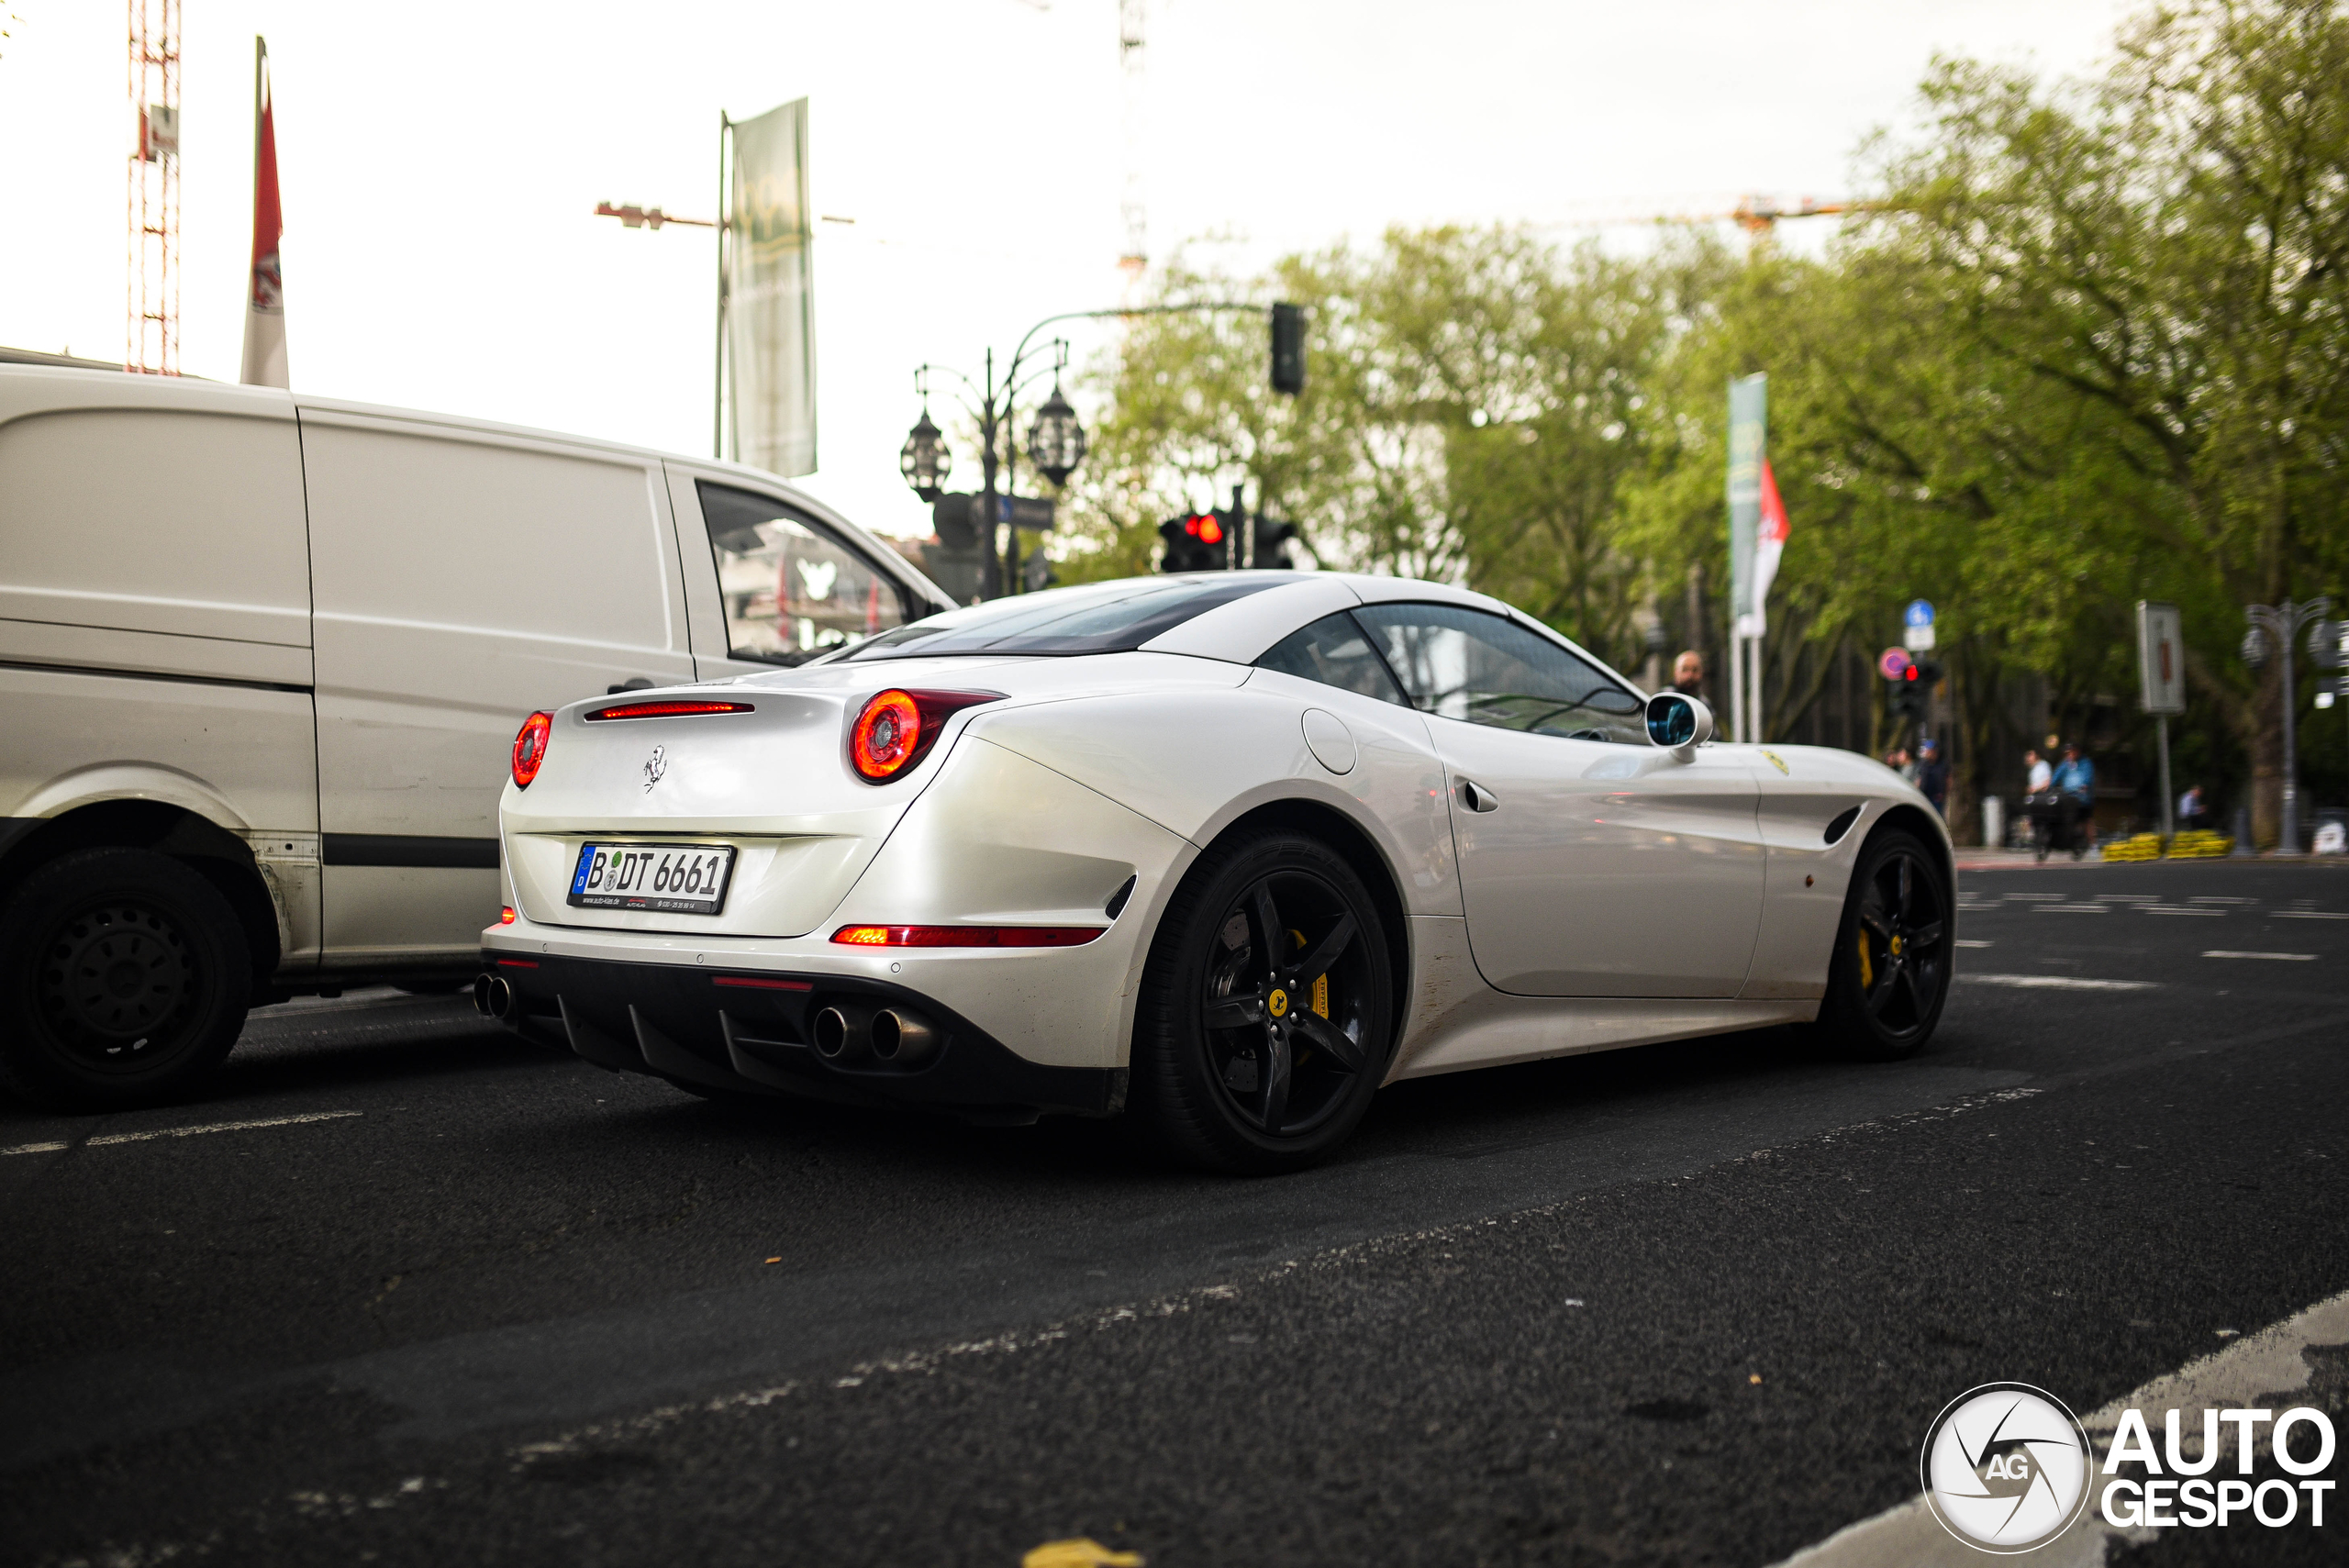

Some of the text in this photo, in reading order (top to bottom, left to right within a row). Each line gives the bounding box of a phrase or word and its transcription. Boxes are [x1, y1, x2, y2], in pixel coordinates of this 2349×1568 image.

[577, 875, 584, 887] D
[587, 852, 720, 895] B DT 6661
